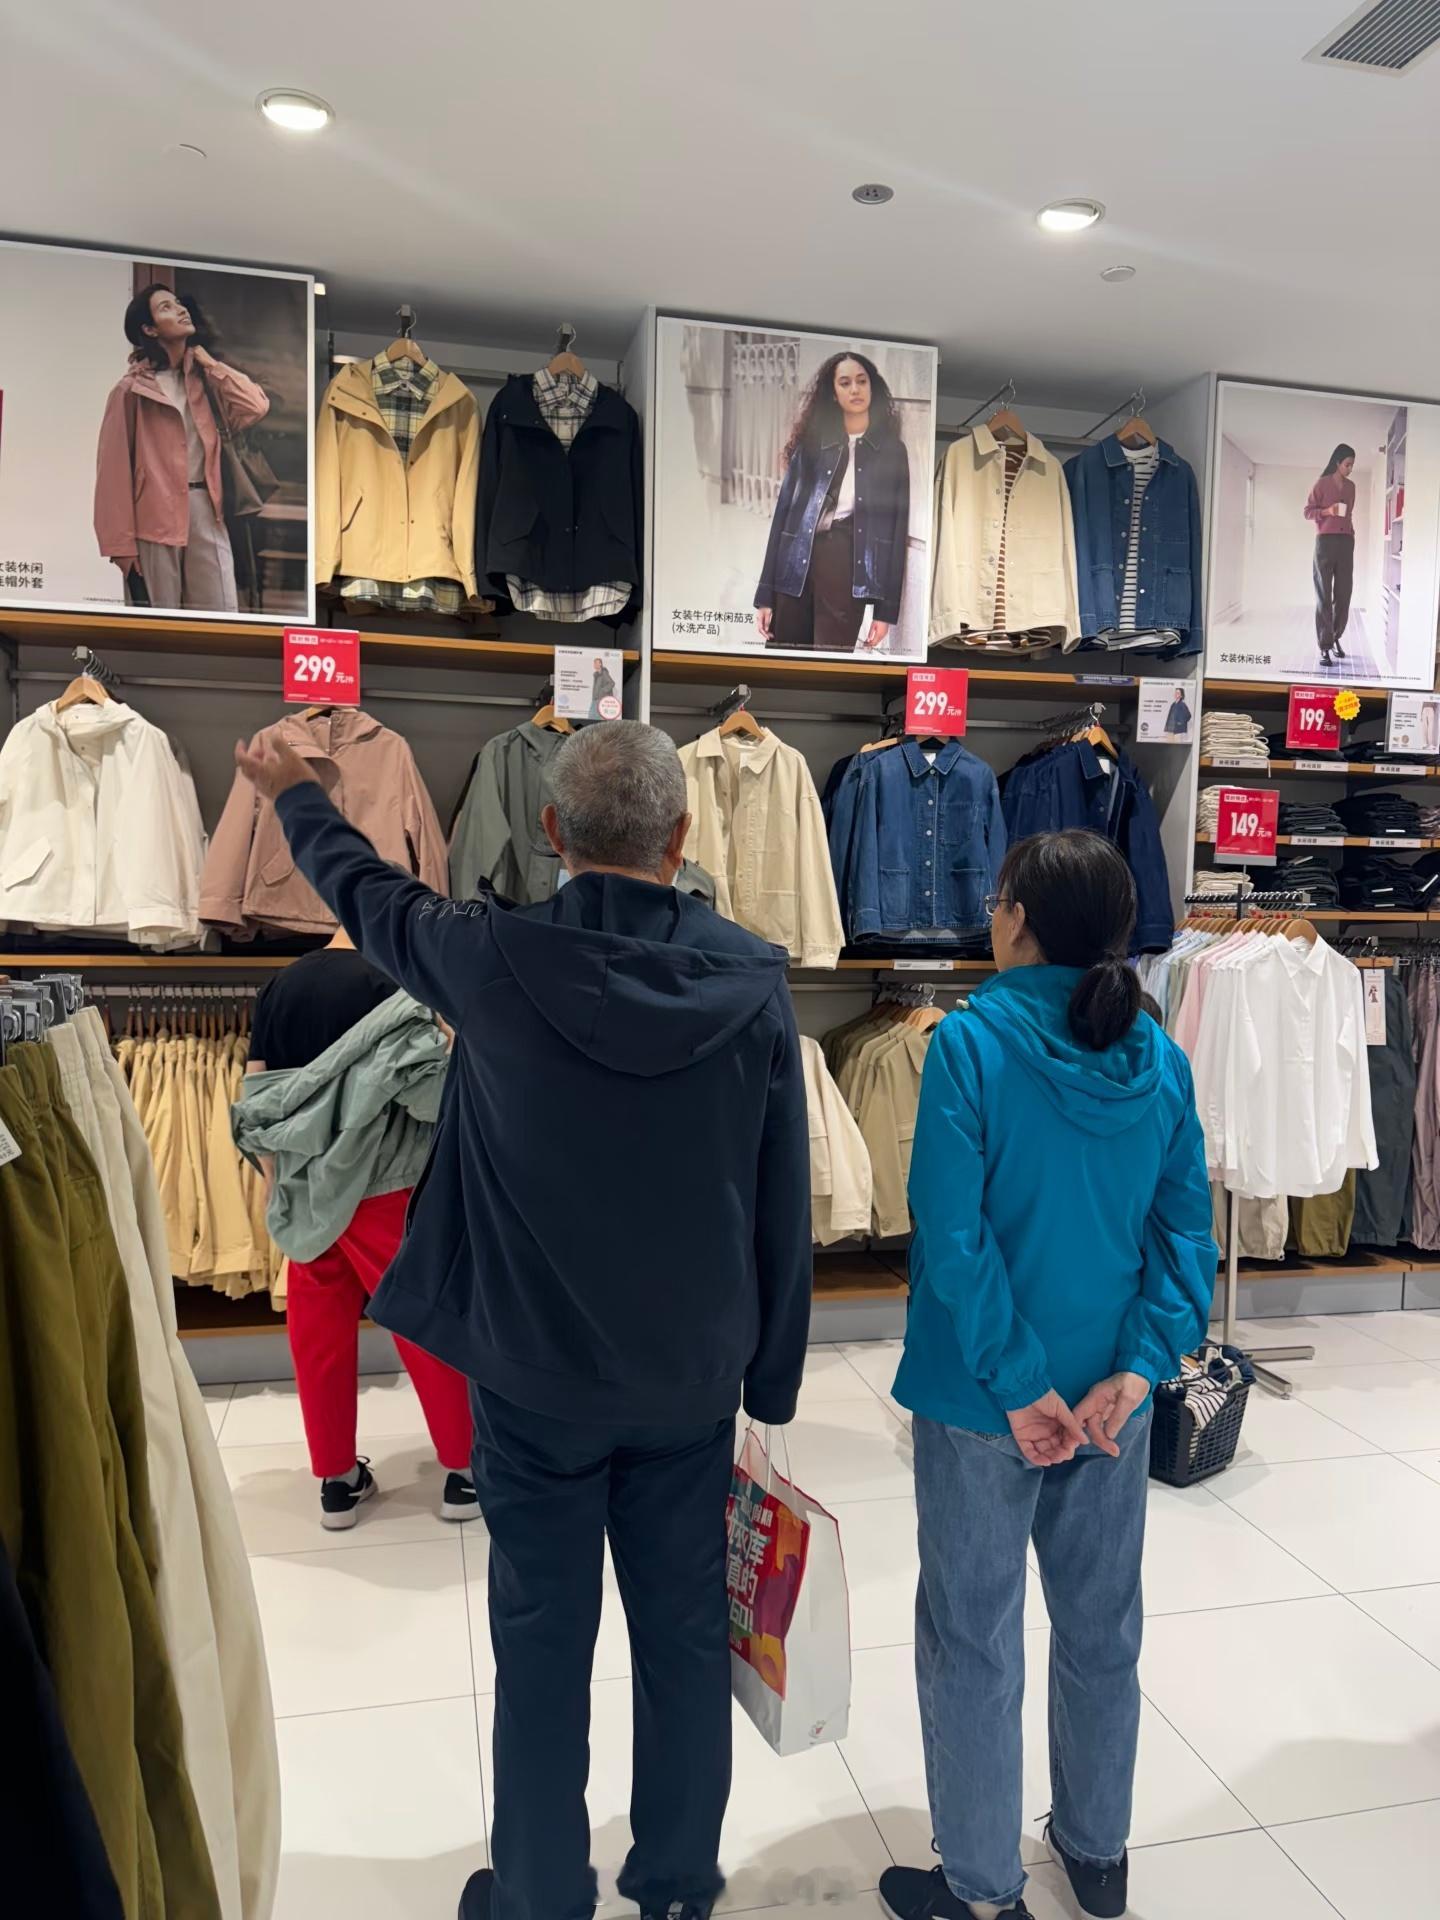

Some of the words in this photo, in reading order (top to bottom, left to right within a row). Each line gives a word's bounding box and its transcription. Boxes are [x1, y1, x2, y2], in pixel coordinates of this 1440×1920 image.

[671, 608, 754, 624] 女装牛仔休闲茄克
[671, 622, 720, 636] (水洗产品)
[1220, 652, 1272, 665] 女装休闲长裤
[728, 1593, 754, 1634] GO!
